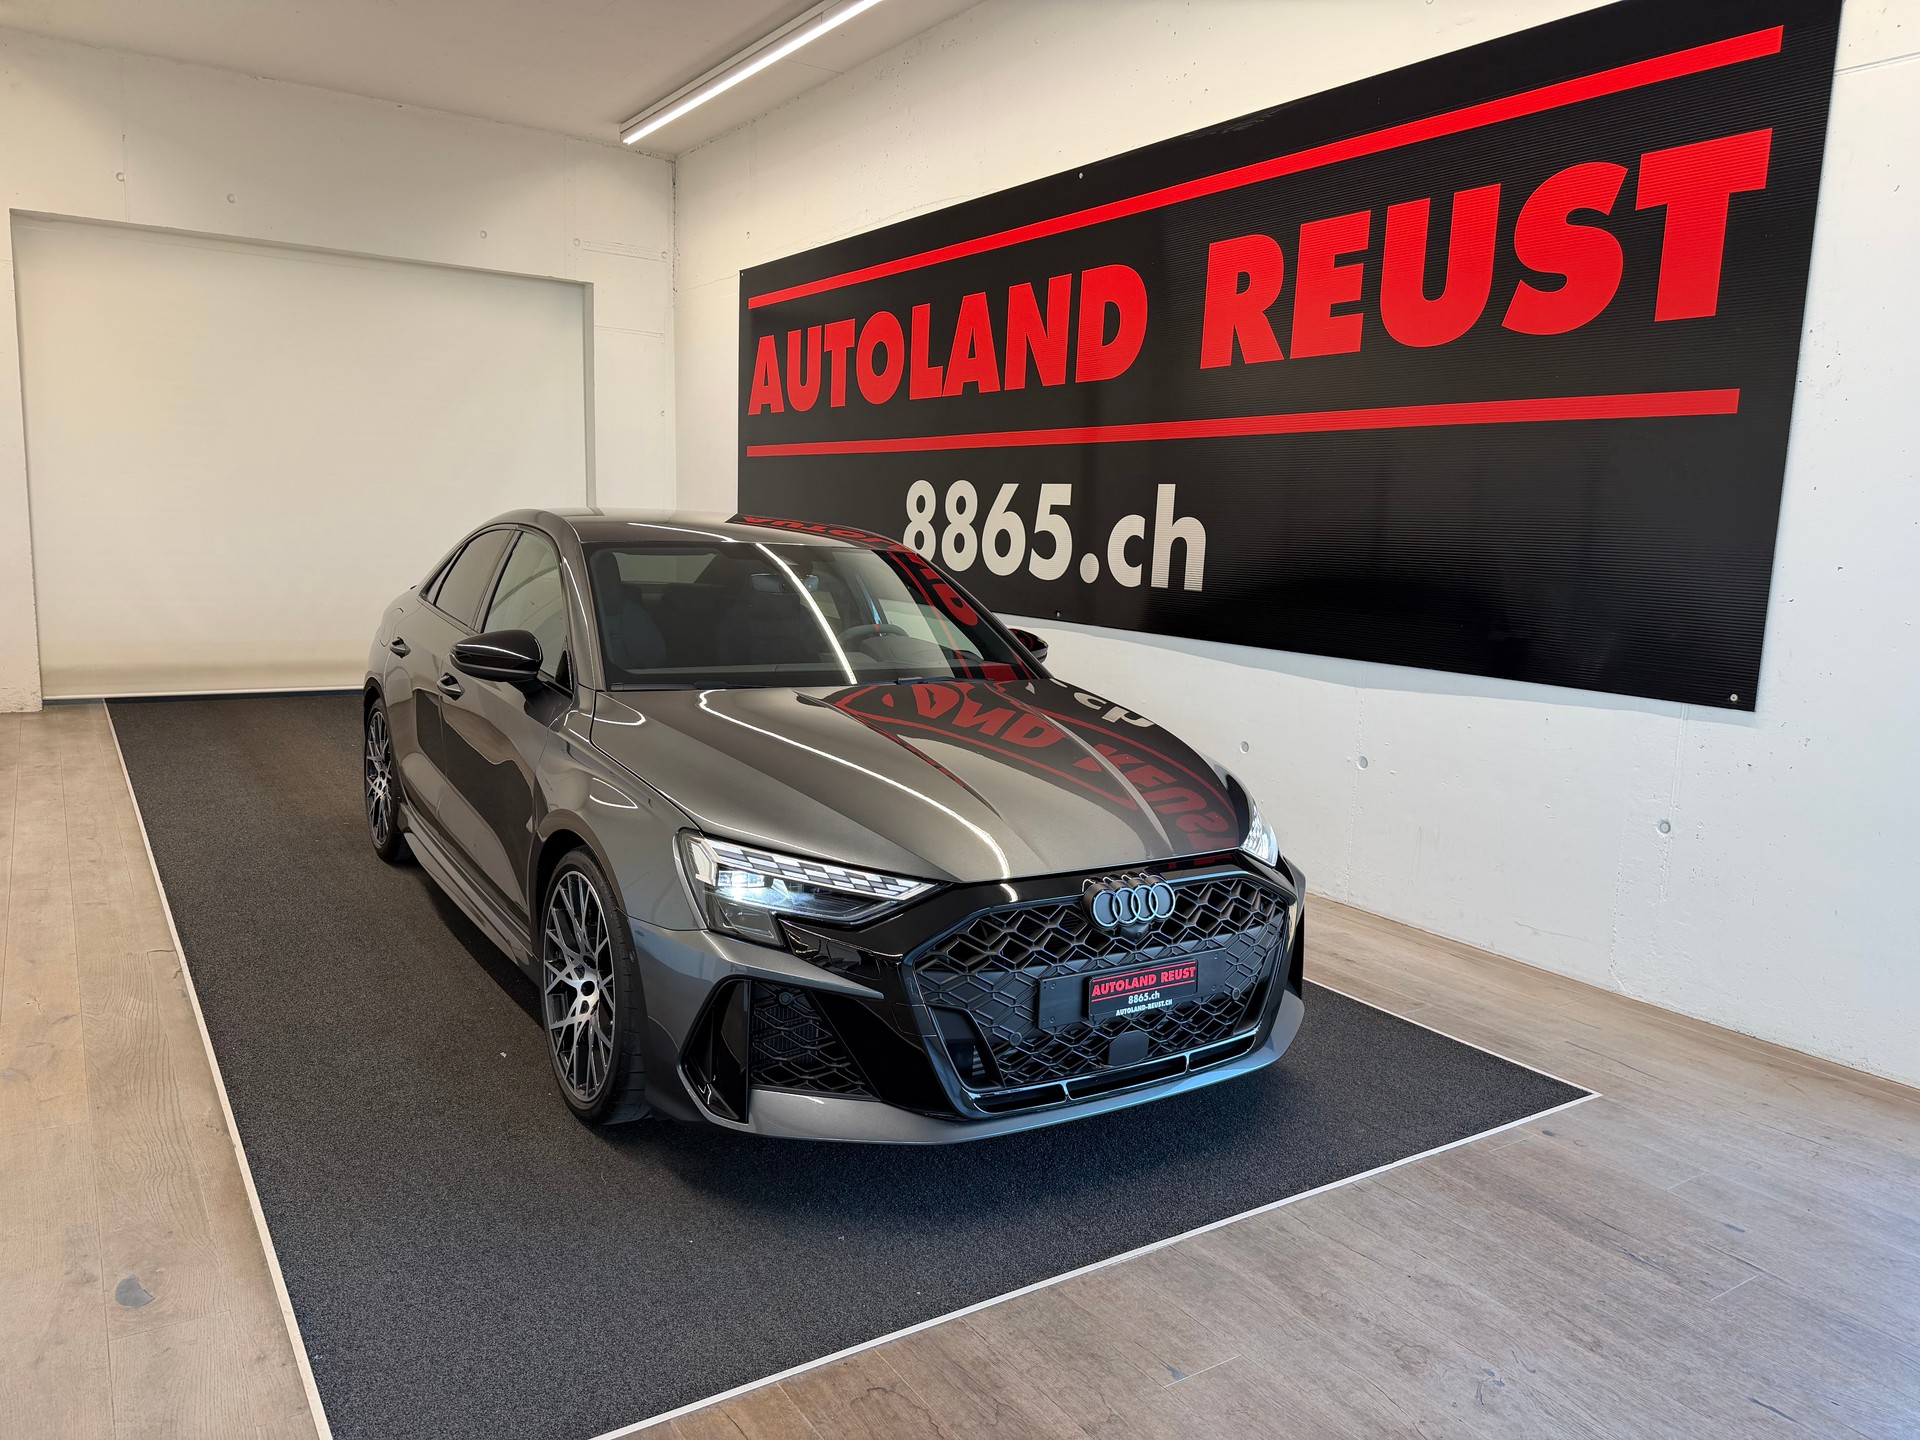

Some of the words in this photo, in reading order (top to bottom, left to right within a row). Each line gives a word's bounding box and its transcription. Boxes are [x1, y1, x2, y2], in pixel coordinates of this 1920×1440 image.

[748, 265, 1149, 416] AUTOLAND
[1200, 128, 1774, 370] REUST
[902, 479, 1207, 592] 8865.ch
[1091, 974, 1157, 997] AUTOLAND
[1160, 966, 1196, 983] REUST
[1128, 990, 1160, 1004] 8865.ch
[1115, 999, 1173, 1017] AUTOLAND-REUST.CH
